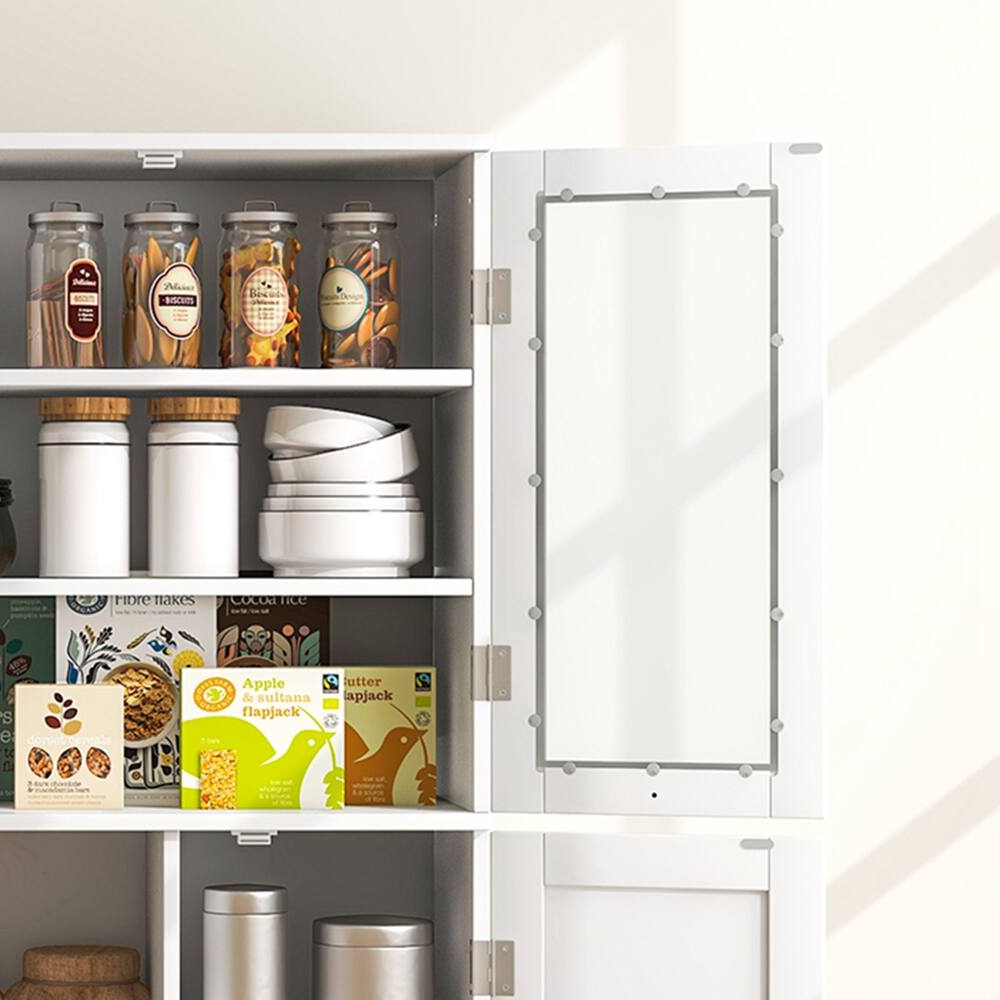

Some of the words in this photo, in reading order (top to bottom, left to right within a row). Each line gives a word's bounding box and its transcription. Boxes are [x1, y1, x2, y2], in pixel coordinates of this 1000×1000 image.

[242, 678, 285, 692] Apple
[242, 692, 253, 703] &
[257, 692, 311, 703] sultana
[344, 690, 393, 703] lapjack
[242, 706, 300, 719] flapjack
